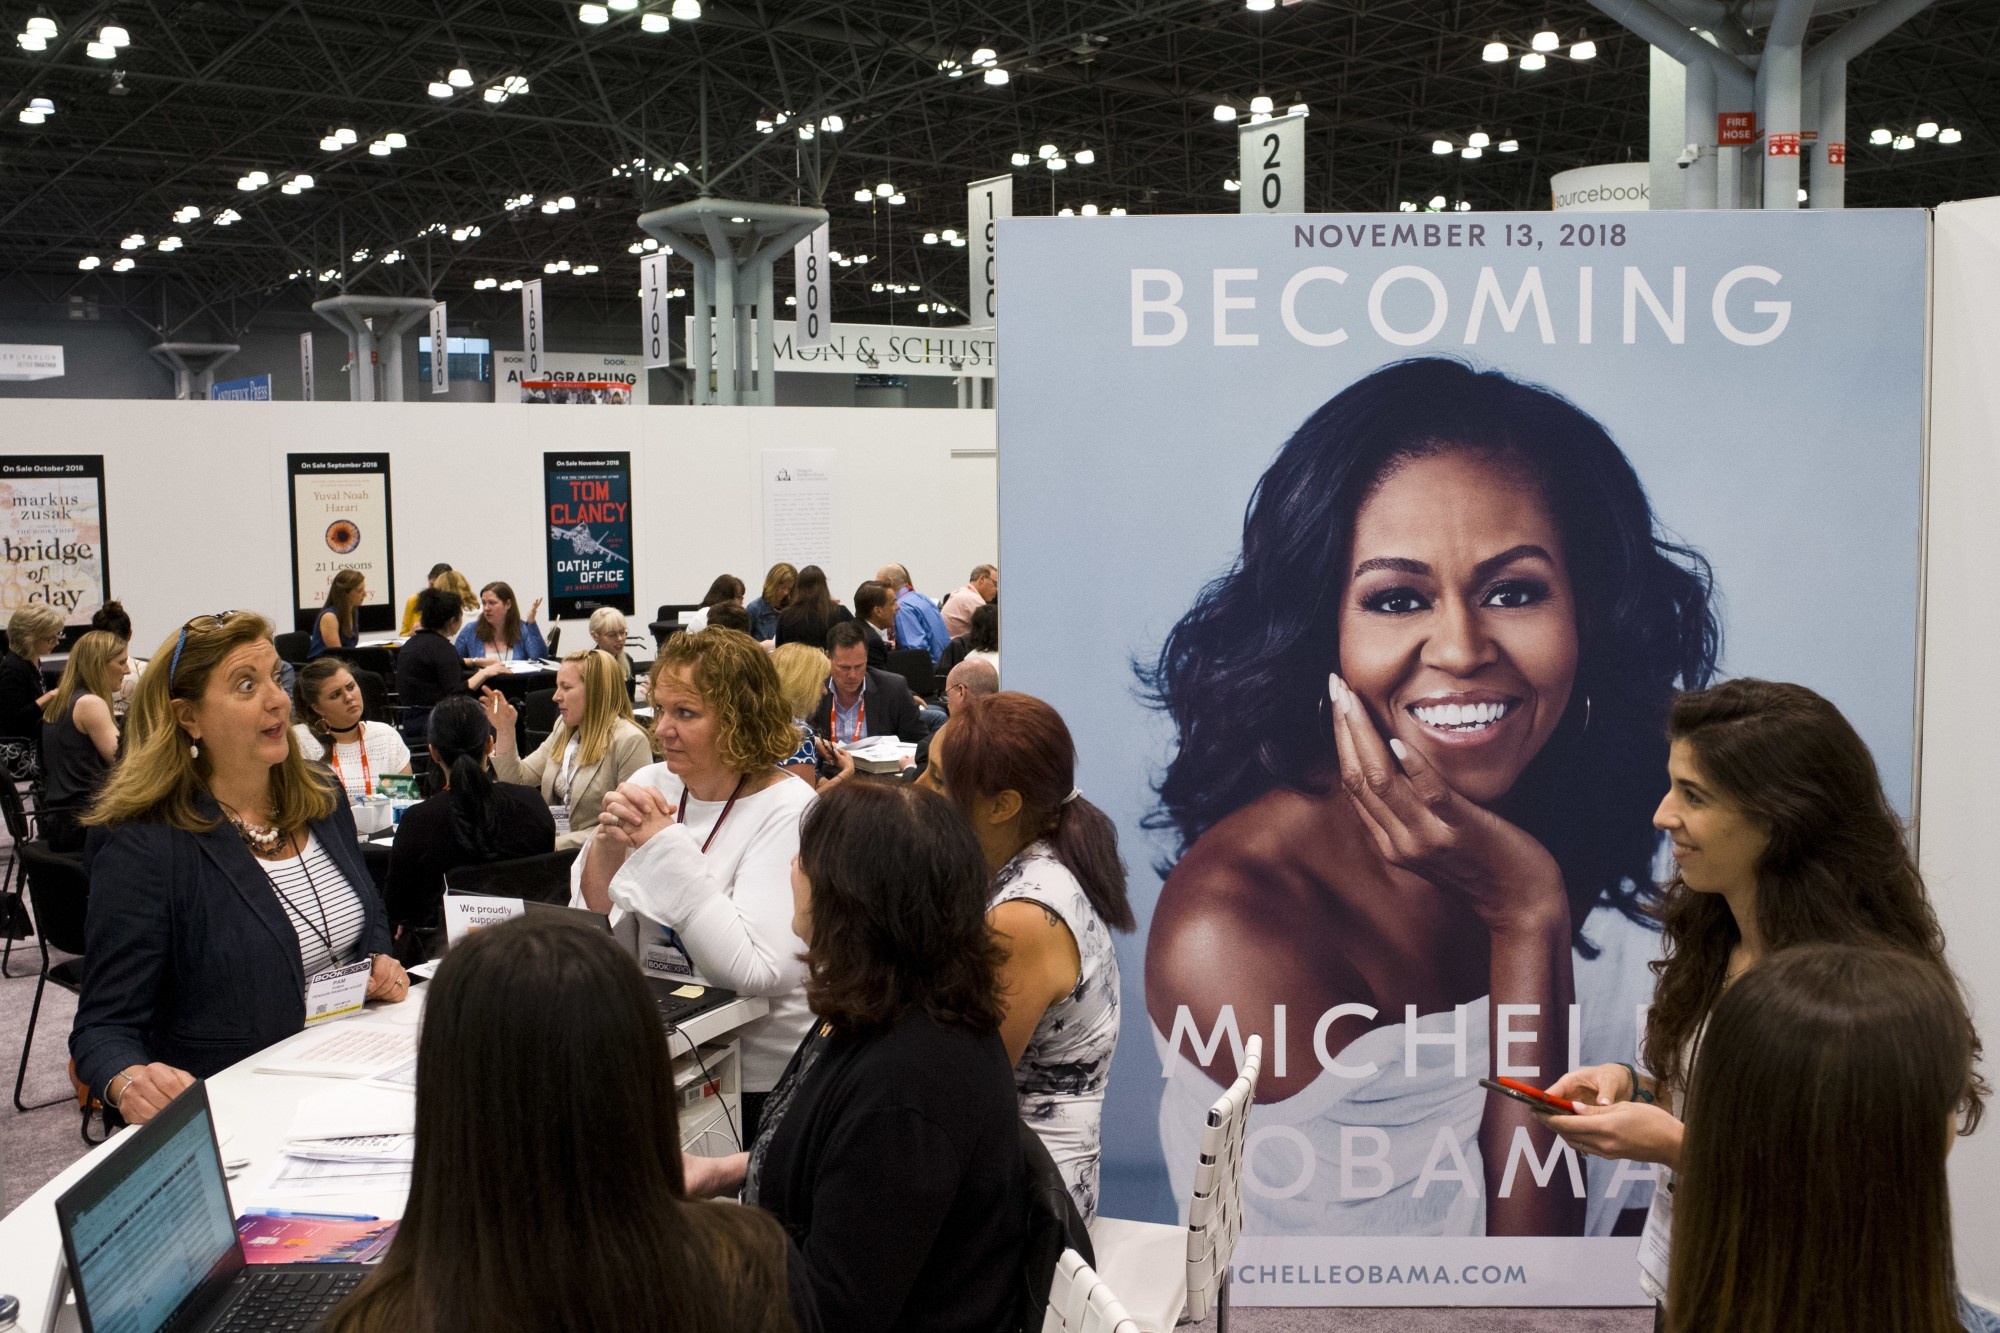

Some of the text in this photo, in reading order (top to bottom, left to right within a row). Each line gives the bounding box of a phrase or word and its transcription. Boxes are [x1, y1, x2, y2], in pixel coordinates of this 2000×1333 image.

[1727, 118, 1748, 126] FIRE
[1723, 130, 1751, 139] HOSE
[1262, 133, 1281, 209] 20
[1294, 222, 1628, 252] NOVEMBER 13, 2018
[808, 232, 818, 339] 1800
[651, 263, 660, 359] 1700
[1130, 264, 1792, 348] BECOMING
[529, 288, 537, 373] 1600
[436, 310, 444, 386] 1500
[888, 335, 996, 366] SCHUST
[503, 356, 525, 364] BOOK
[250, 380, 268, 401] PRESS
[12, 492, 79, 507] markus
[312, 489, 369, 501] Yuval Noah
[569, 480, 610, 502] TOM
[20, 505, 72, 521] zusak
[325, 502, 358, 512] Harari
[550, 502, 628, 524] CLANCY
[3, 537, 94, 566] bridge
[27, 565, 48, 584] of
[314, 560, 373, 572] 21 Lessons
[556, 559, 603, 573] OATH OF
[580, 569, 625, 583] OFFICE
[28, 583, 85, 614] clay
[459, 904, 512, 917] We proudly
[469, 916, 505, 925] support
[314, 962, 370, 983] BOOKEXPO
[648, 960, 690, 974] BOOKEXPO
[1160, 1002, 1652, 1080] MICHEL
[1228, 1264, 1527, 1285] ICHELLEOBAMA.COM
